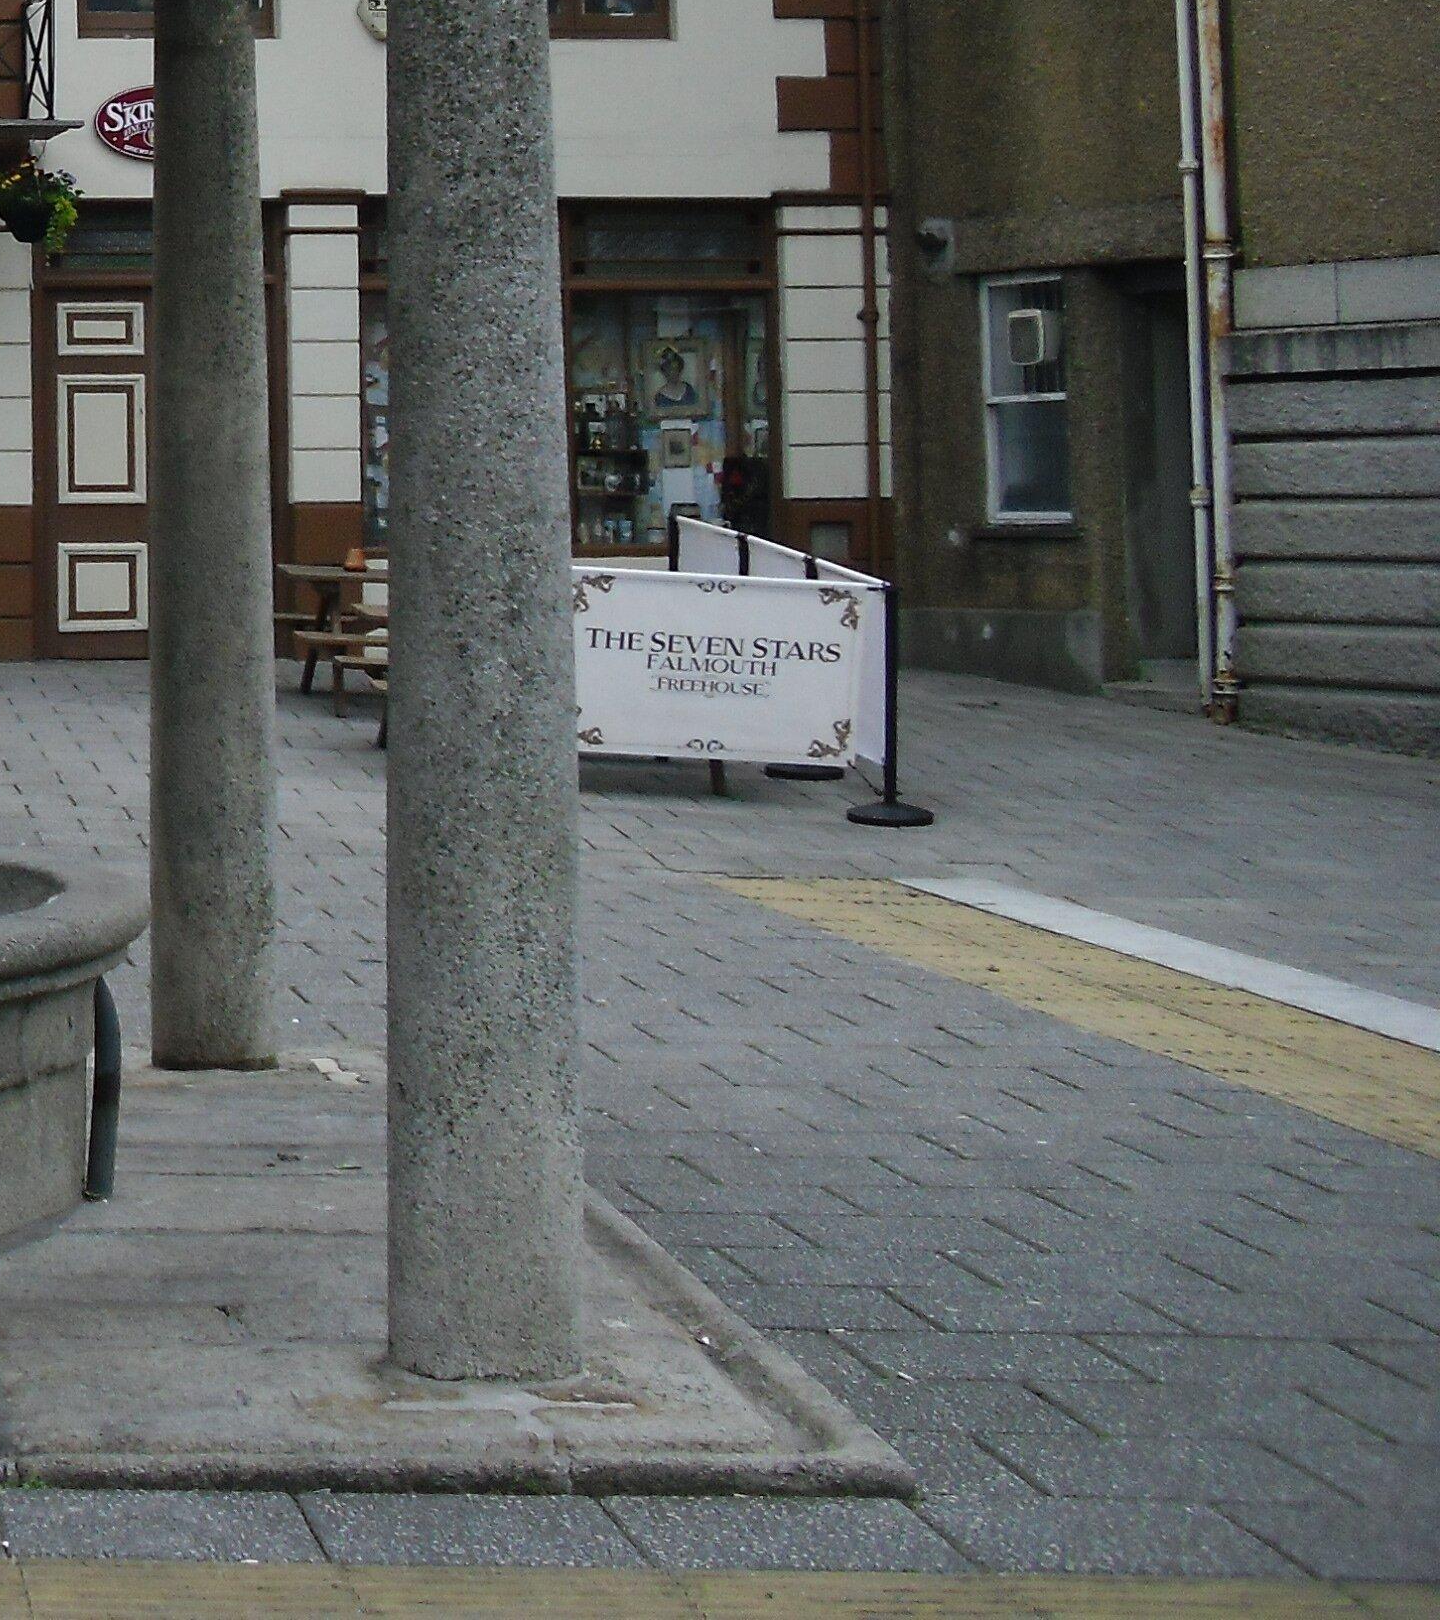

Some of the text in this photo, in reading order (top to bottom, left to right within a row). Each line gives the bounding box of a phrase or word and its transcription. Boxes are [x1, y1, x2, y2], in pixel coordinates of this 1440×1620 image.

[585, 627, 842, 663] THE SEVEN STARS
[646, 653, 777, 677] FALMOUTH
[656, 676, 767, 697] FREEHOUSE
